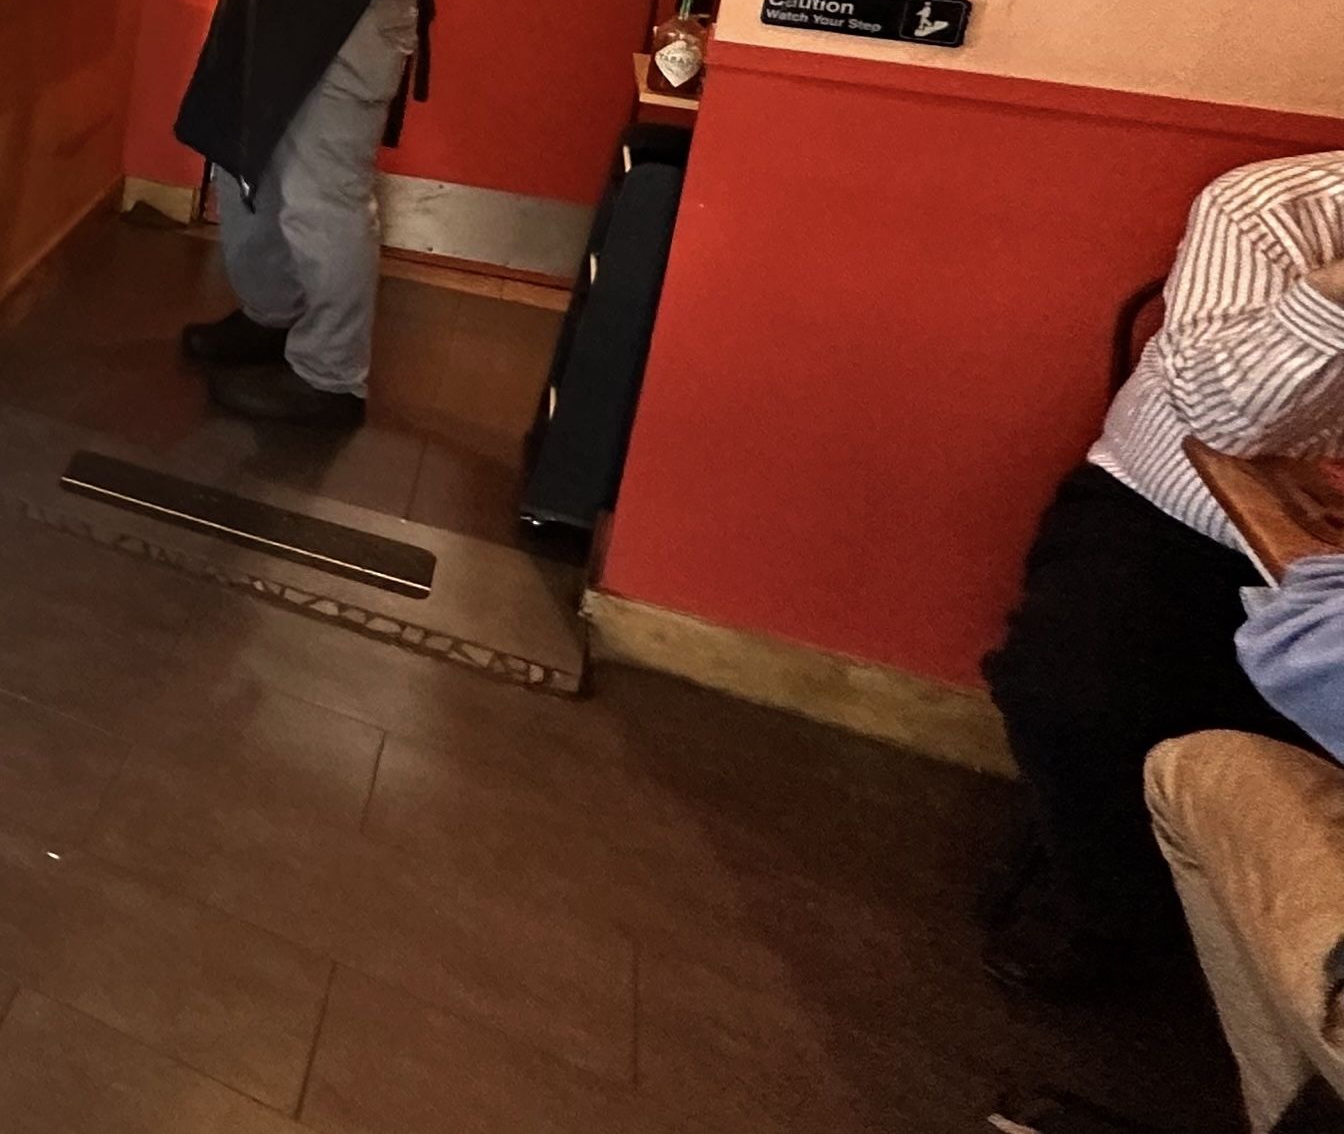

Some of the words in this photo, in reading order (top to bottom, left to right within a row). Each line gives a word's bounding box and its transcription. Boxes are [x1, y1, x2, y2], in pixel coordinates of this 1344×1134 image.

[766, 8, 809, 23] Watch
[812, 13, 846, 27] Your
[847, 18, 882, 33] Step
